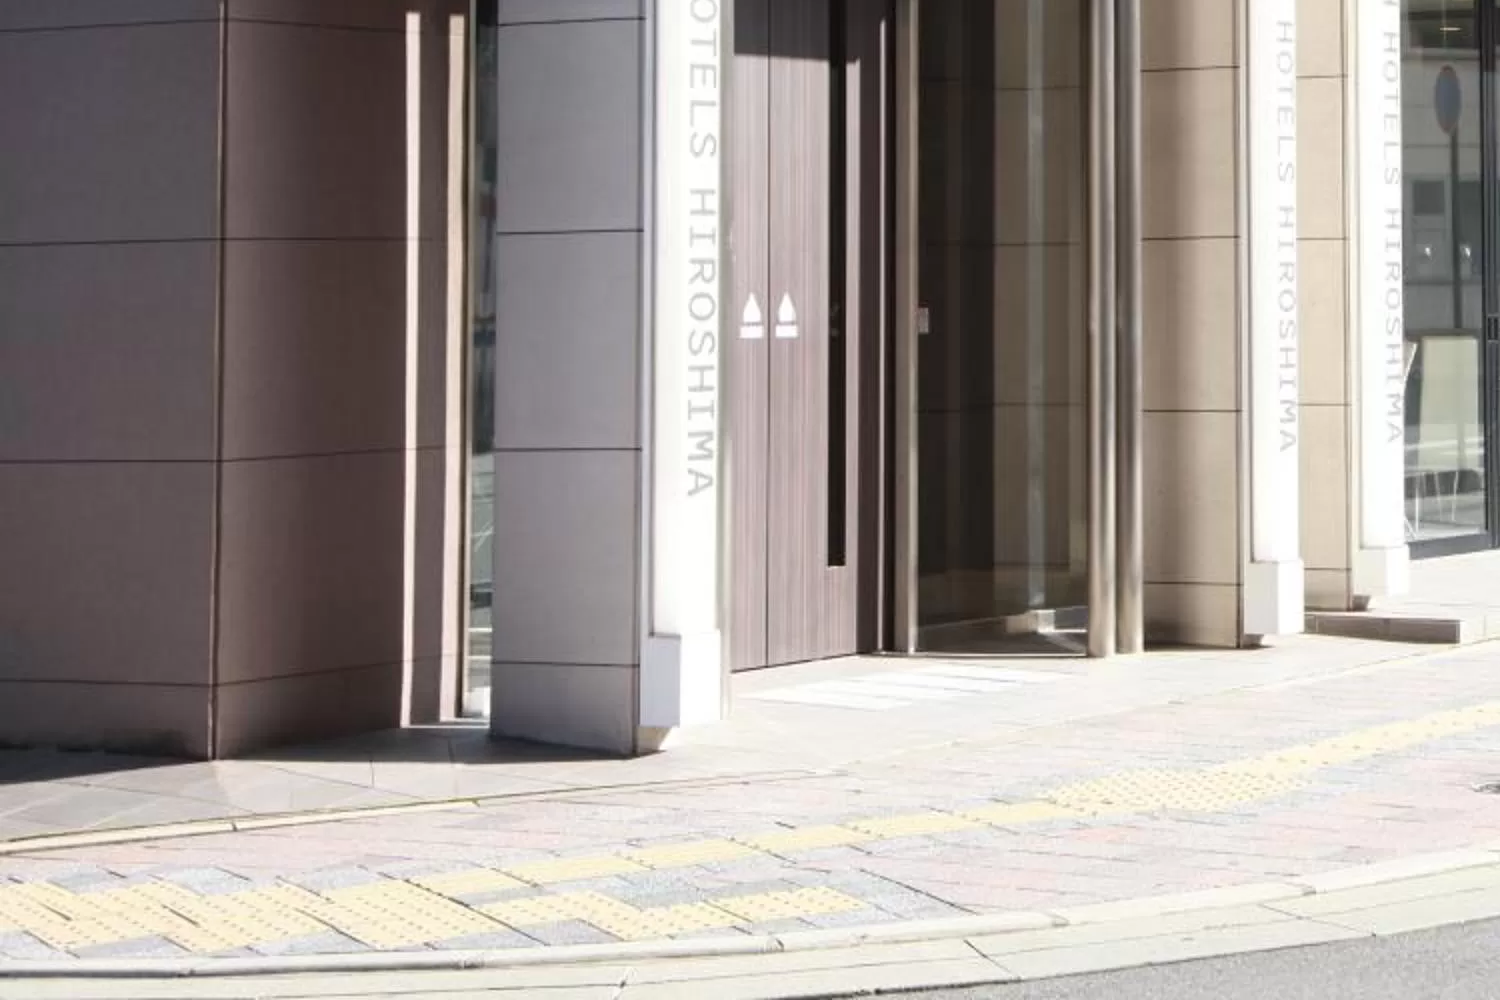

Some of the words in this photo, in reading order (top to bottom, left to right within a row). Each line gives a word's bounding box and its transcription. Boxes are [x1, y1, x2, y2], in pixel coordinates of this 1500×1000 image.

[1276, 20, 1296, 184] HOTELS
[1381, 30, 1401, 186] HOTELS
[686, 187, 717, 498] HIROSHIMA
[1277, 205, 1298, 453] HIROSHIMA
[1383, 206, 1405, 444] HIROSHIMA
